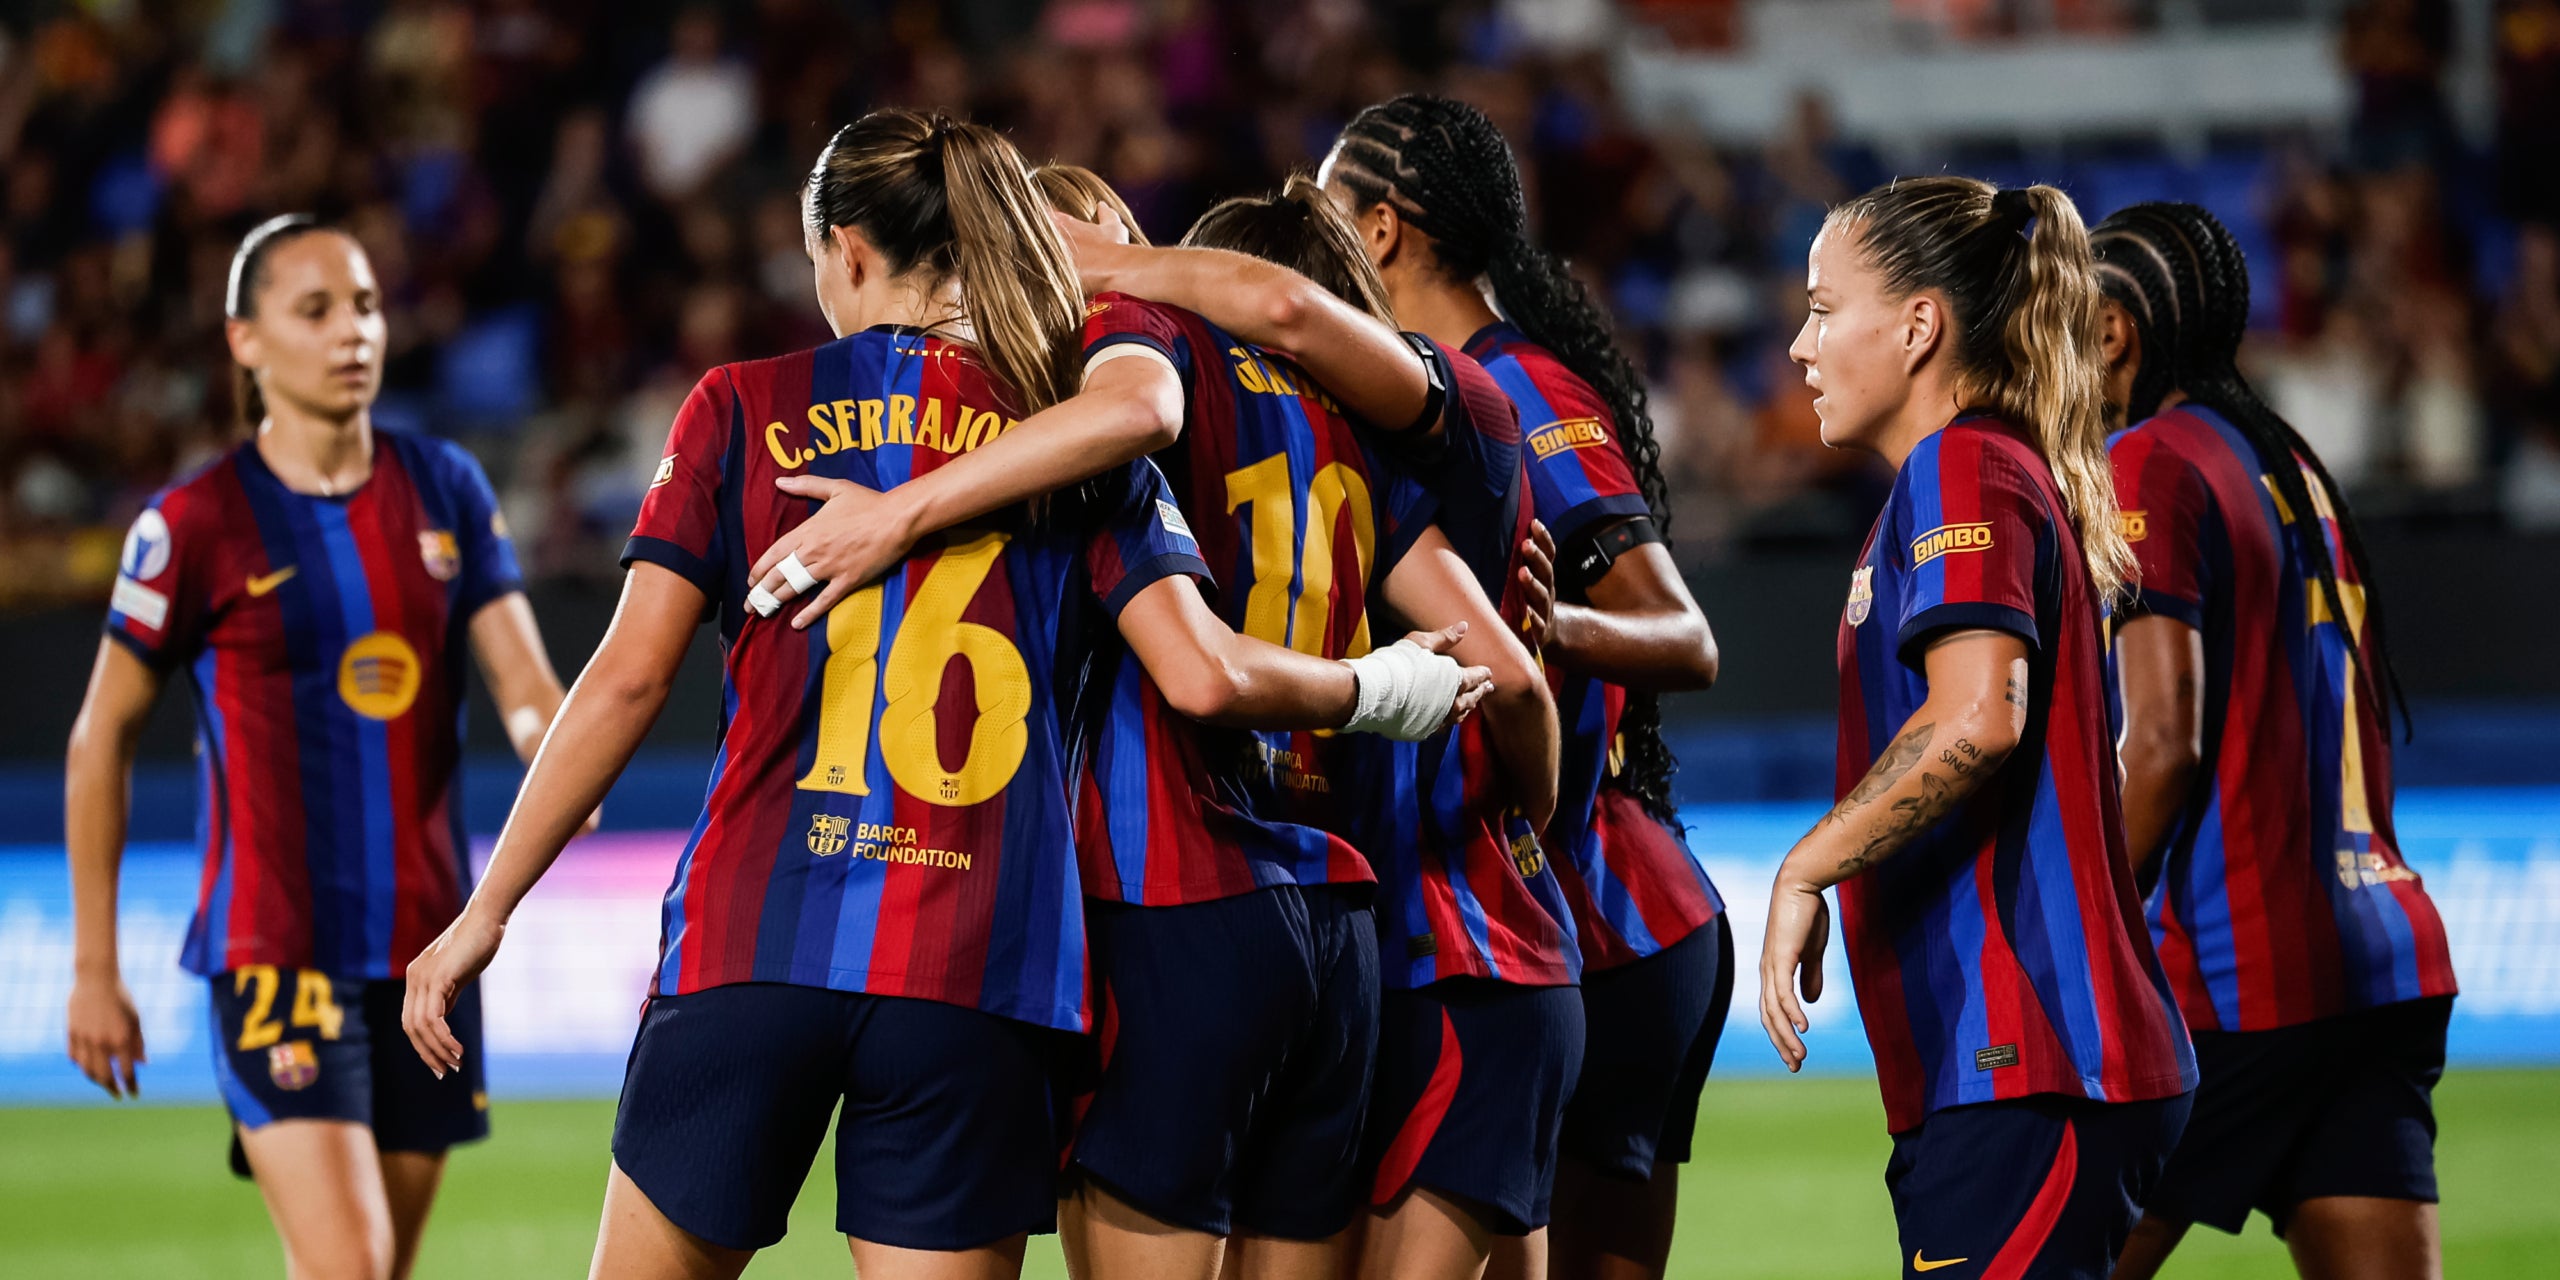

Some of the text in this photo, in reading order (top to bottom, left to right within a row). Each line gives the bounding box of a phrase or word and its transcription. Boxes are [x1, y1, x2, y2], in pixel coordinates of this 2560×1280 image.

[764, 394, 1019, 470] C.SERRAJO
[1529, 421, 1604, 456] BIMBO
[1224, 451, 1375, 662] 10
[1913, 525, 1992, 563] BIMBO
[795, 531, 1032, 807] 16
[1954, 737, 1982, 760] CON
[856, 823, 918, 845] BARÇA
[852, 842, 972, 871] FOUNDATION
[234, 963, 344, 1052] 24
